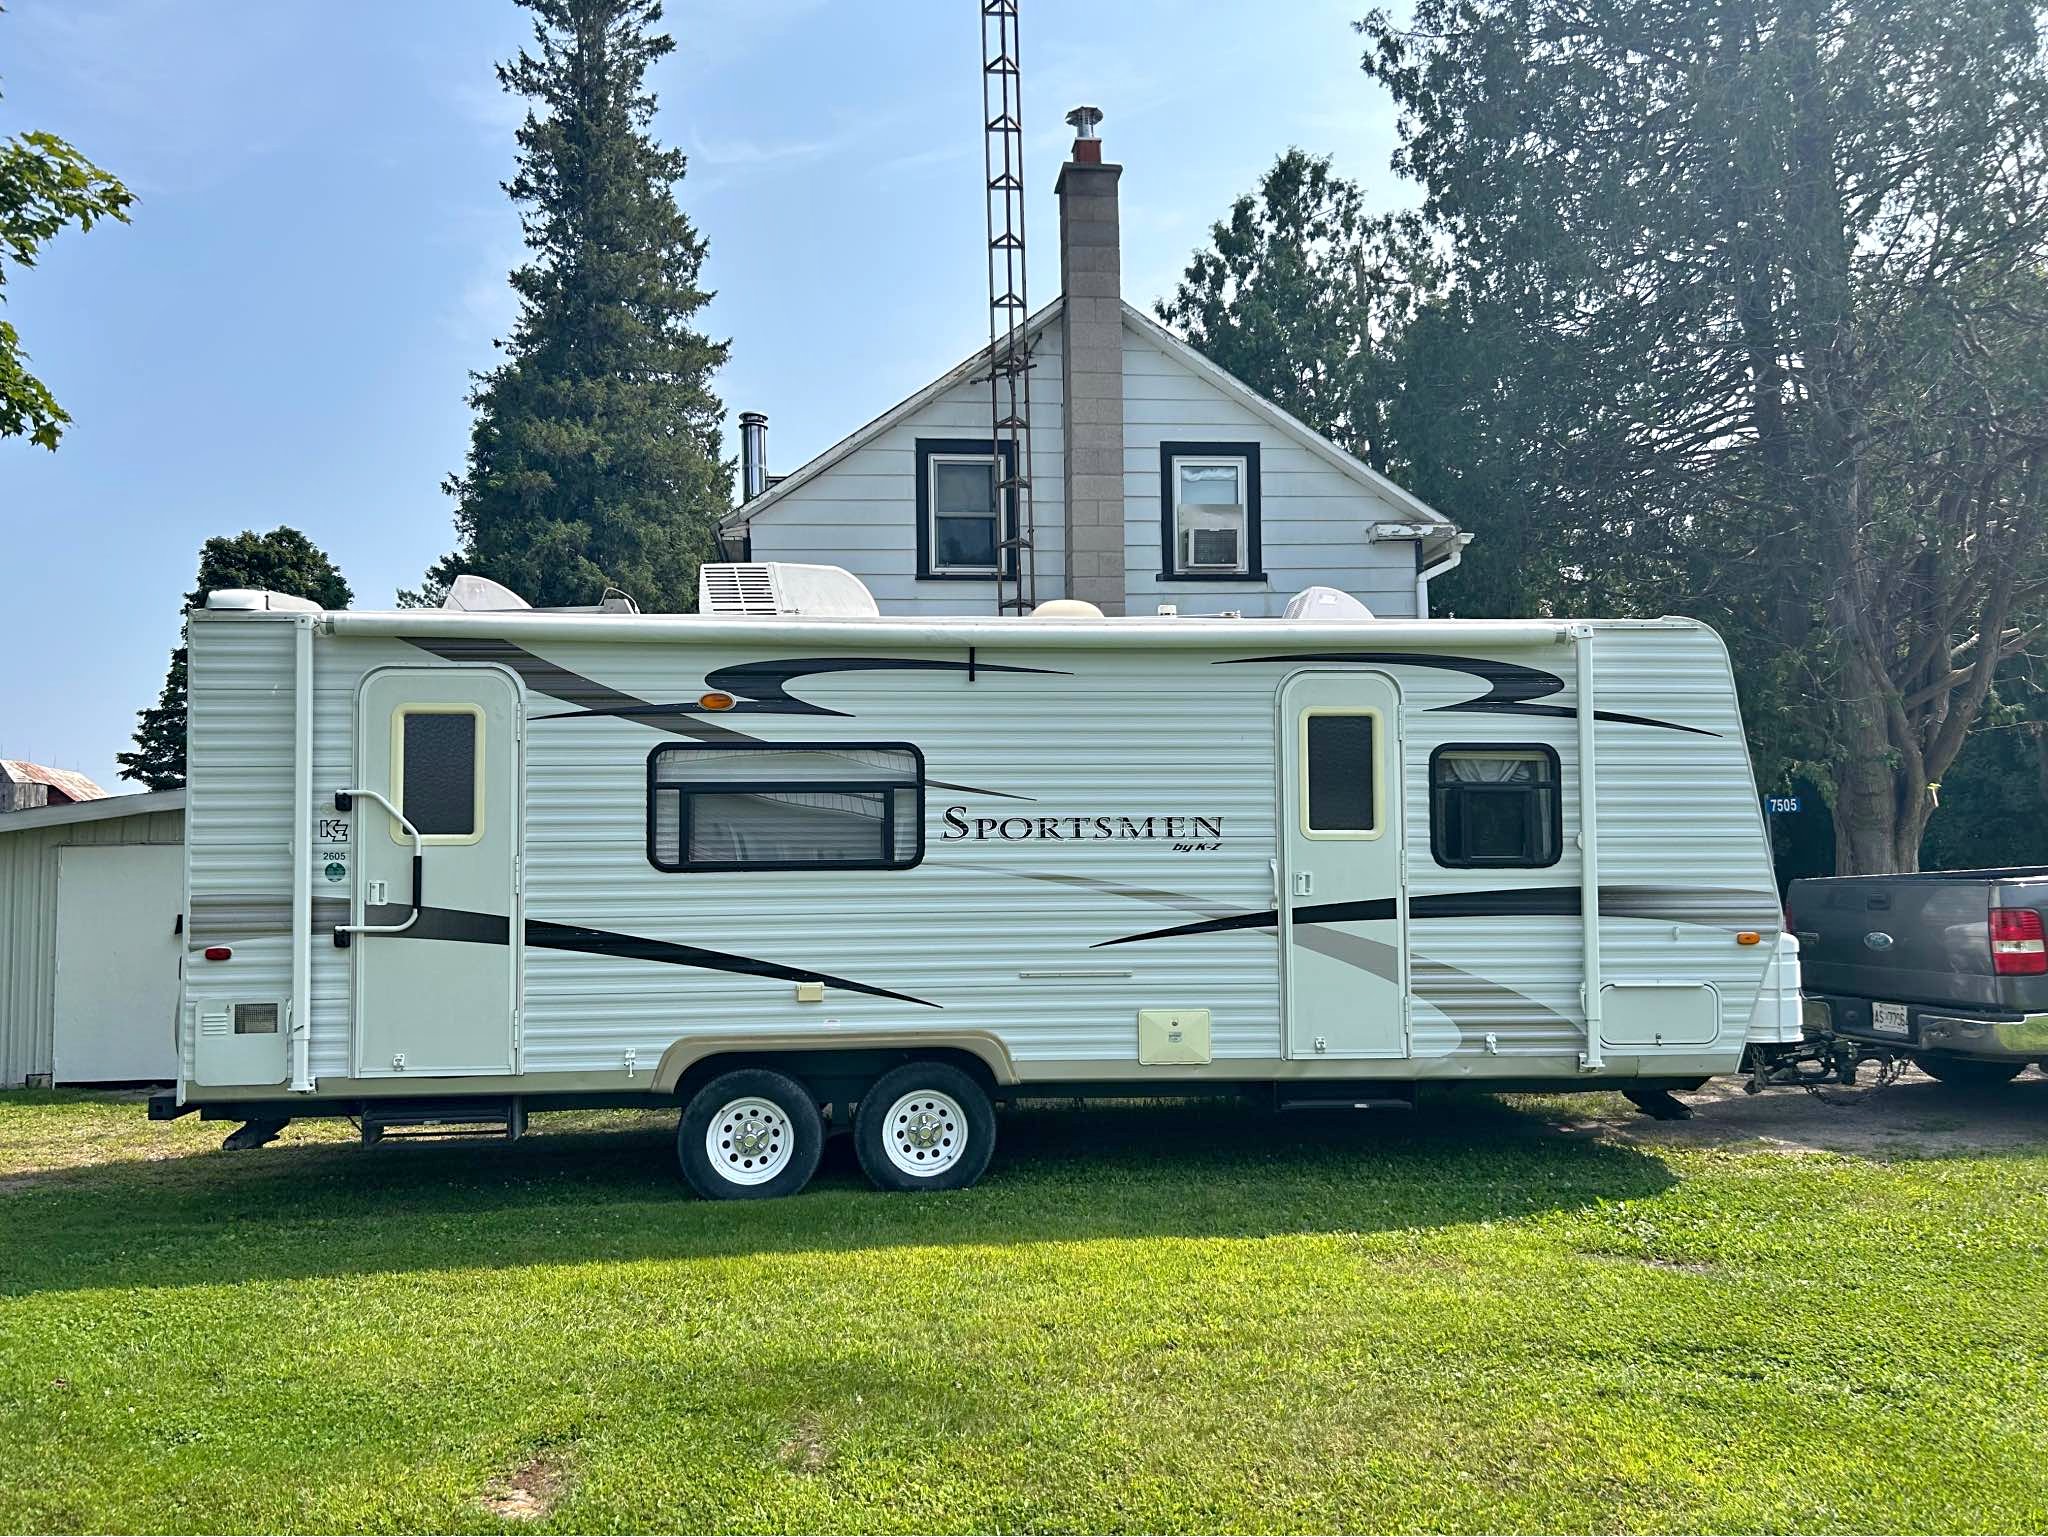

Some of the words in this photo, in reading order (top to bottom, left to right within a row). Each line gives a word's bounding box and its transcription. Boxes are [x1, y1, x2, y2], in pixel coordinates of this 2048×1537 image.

[1770, 798, 1797, 812] 7505
[940, 806, 1224, 842] SPORTSMEN
[1172, 842, 1194, 853] by
[1195, 842, 1224, 851] K-Z
[323, 852, 346, 861] 2605
